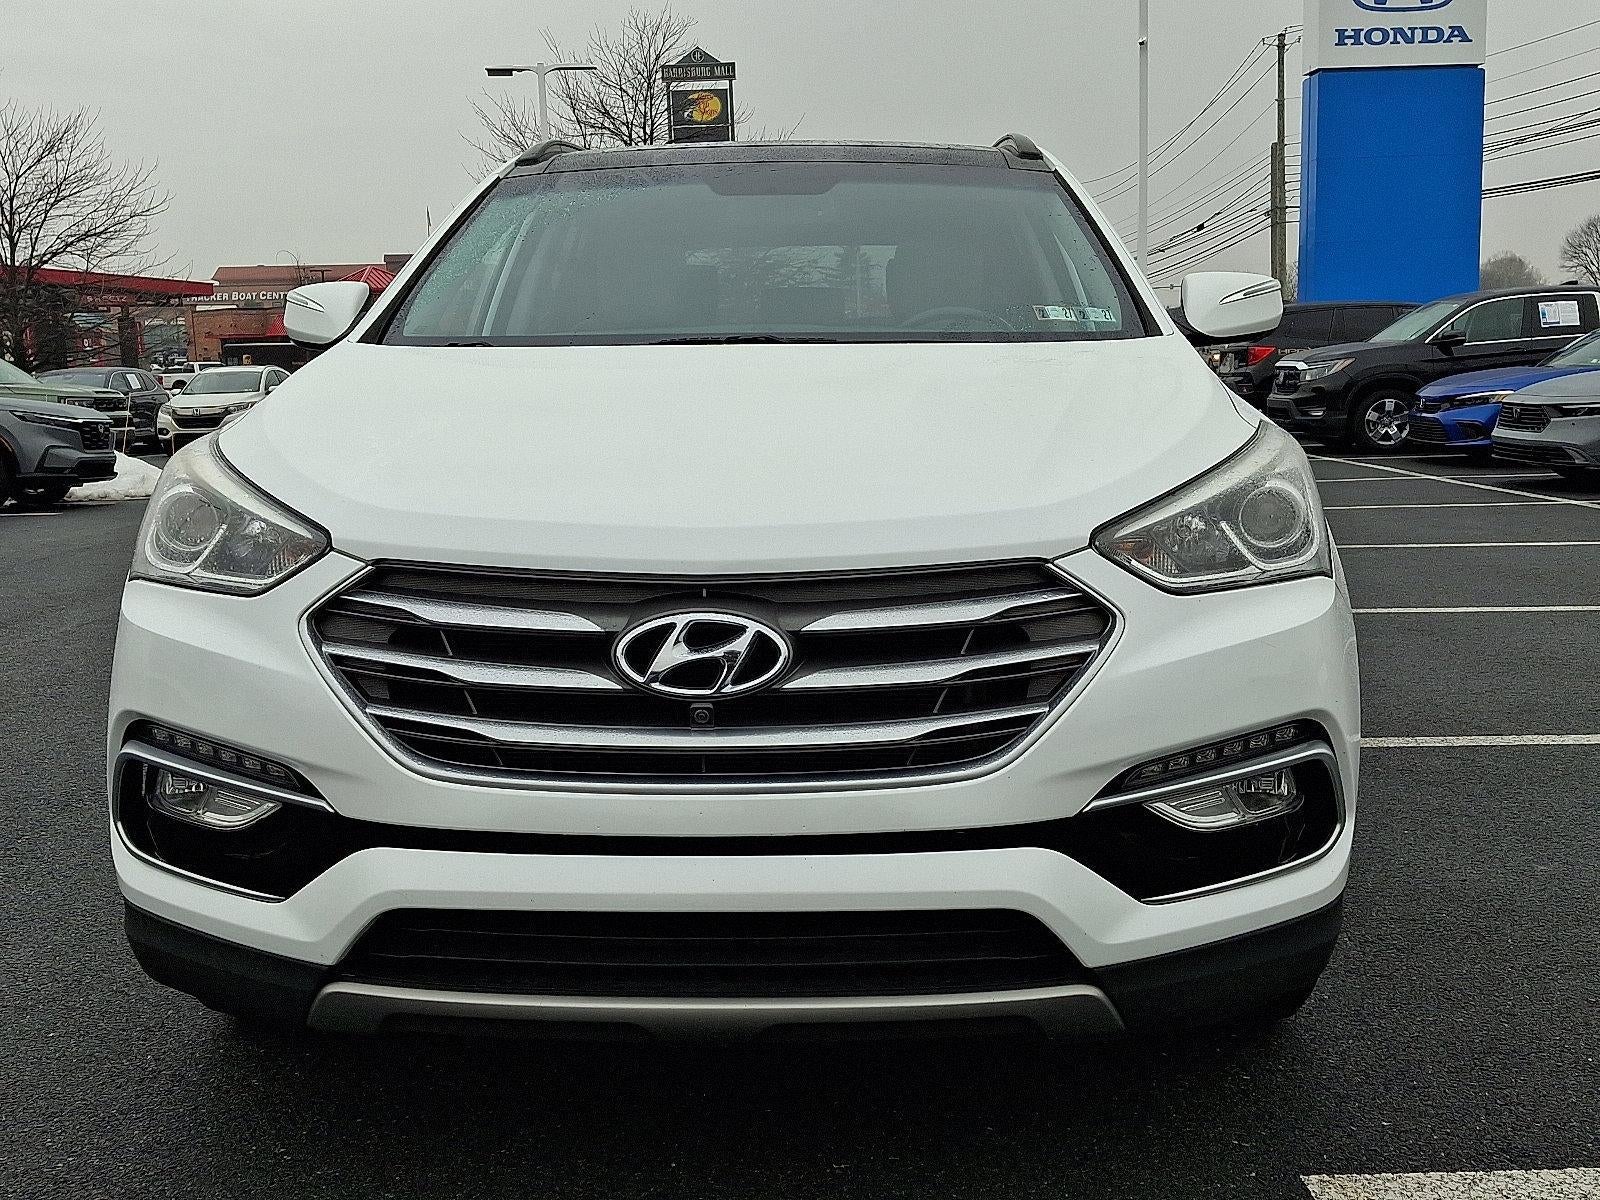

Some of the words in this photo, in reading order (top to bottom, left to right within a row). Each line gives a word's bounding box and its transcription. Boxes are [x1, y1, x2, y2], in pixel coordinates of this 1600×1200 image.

[1335, 26, 1473, 46] HONDA
[714, 66, 734, 76] MALL
[231, 291, 258, 300] BOAT
